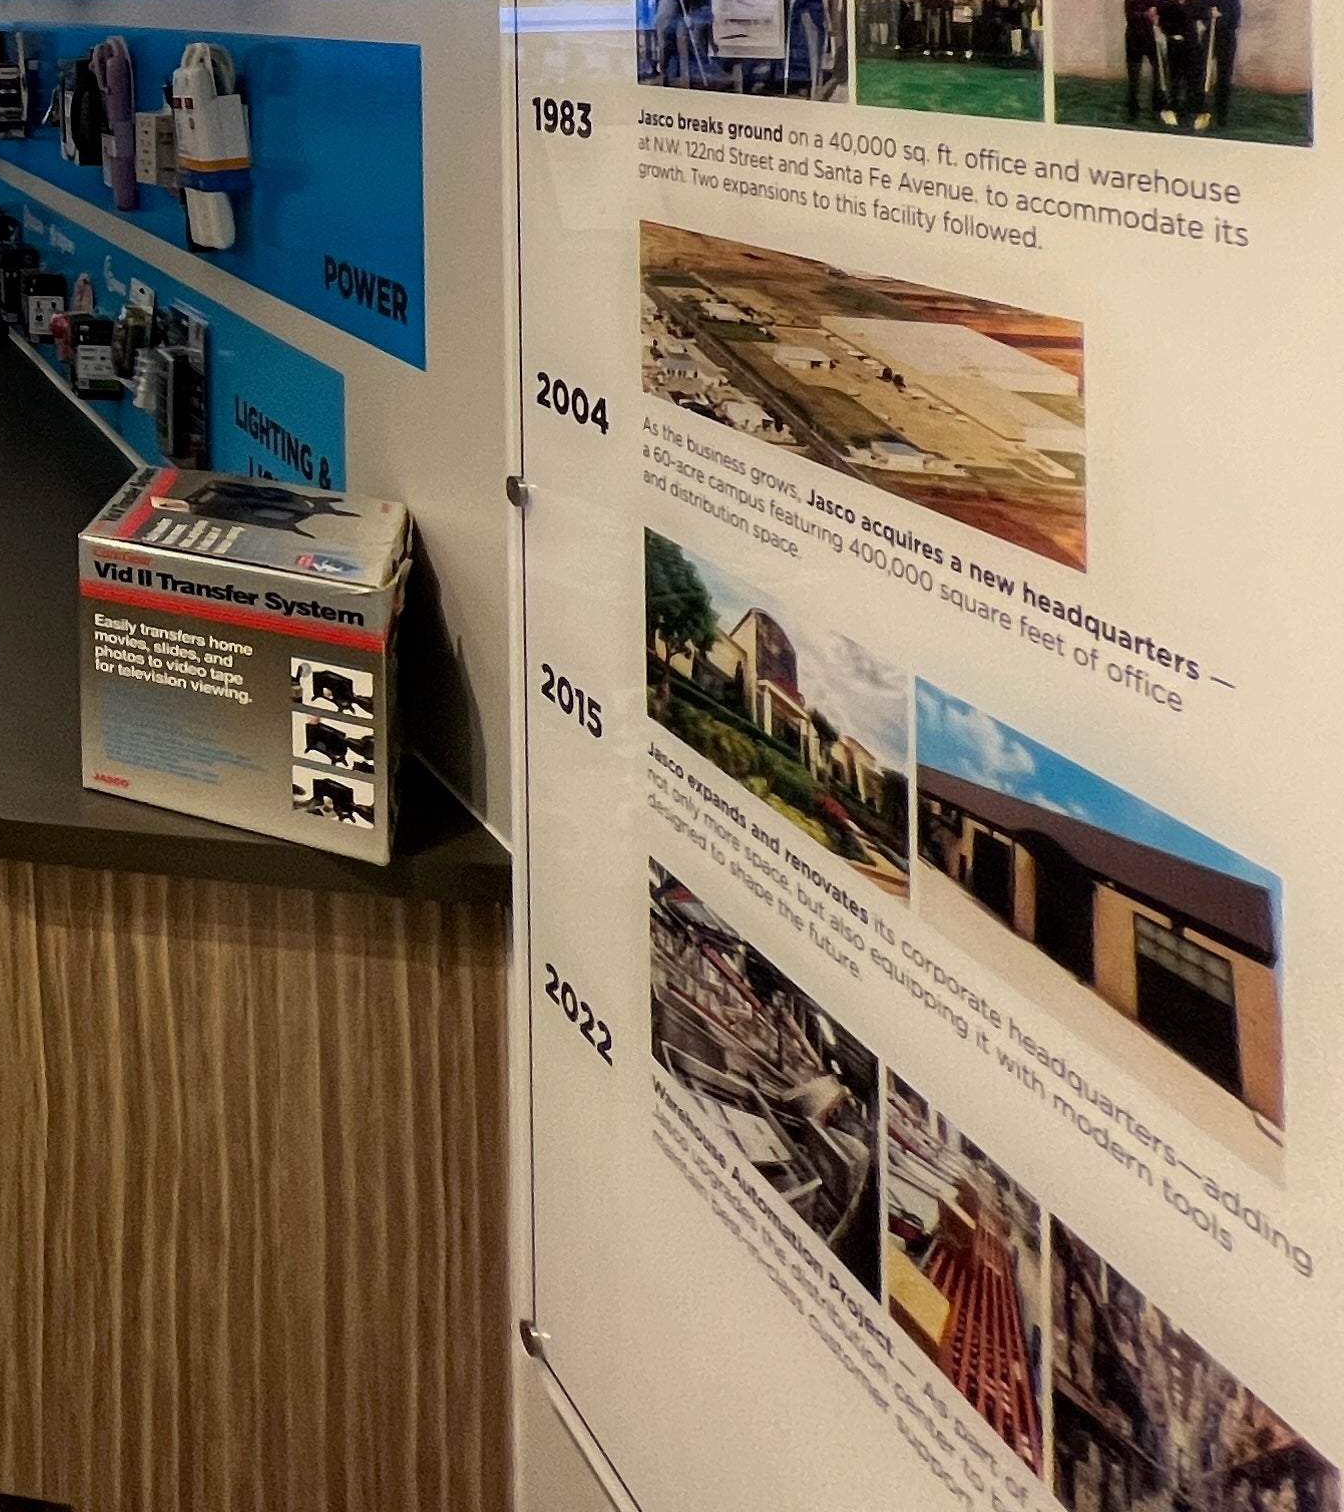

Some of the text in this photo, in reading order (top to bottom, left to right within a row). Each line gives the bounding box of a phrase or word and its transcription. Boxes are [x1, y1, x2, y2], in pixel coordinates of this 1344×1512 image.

[532, 97, 593, 138] 1983
[638, 109, 1241, 205] Jasco breaks ground 40,000 sq. ft. office and warehouse
[685, 140, 725, 163] 122nd
[728, 146, 774, 171] Street
[778, 155, 809, 177] and
[813, 159, 863, 185] Santa
[868, 167, 892, 190] Fe
[986, 184, 1009, 208] to
[1015, 192, 1204, 240] accommodate
[1214, 215, 1250, 247] its
[638, 160, 1043, 250] growth. Two expansions to this facility followed.
[324, 255, 409, 326] POWER
[536, 371, 609, 435] 2004
[235, 393, 313, 480] LIGHTING
[320, 457, 331, 489] &
[662, 424, 684, 448] the
[686, 434, 747, 476] business
[806, 488, 856, 525] Jasco
[861, 512, 944, 565] acquires
[970, 561, 1015, 597] new
[1022, 581, 1200, 681] headquarters
[95, 561, 133, 584] Vid
[156, 573, 259, 605] Transfer
[264, 591, 364, 626] System
[94, 613, 253, 656] Easily transfers home
[94, 630, 233, 668] movies, slides, and
[94, 645, 244, 688] photos to video tape
[95, 658, 253, 705] for television viewing.
[541, 663, 603, 738] 2015
[647, 741, 1002, 1030] Jasco expands and renovates its corporate
[543, 961, 615, 1068] 2022
[651, 1075, 727, 1170] Warehouse
[731, 1165, 824, 1281] Automation
[828, 1270, 894, 1360] Project
